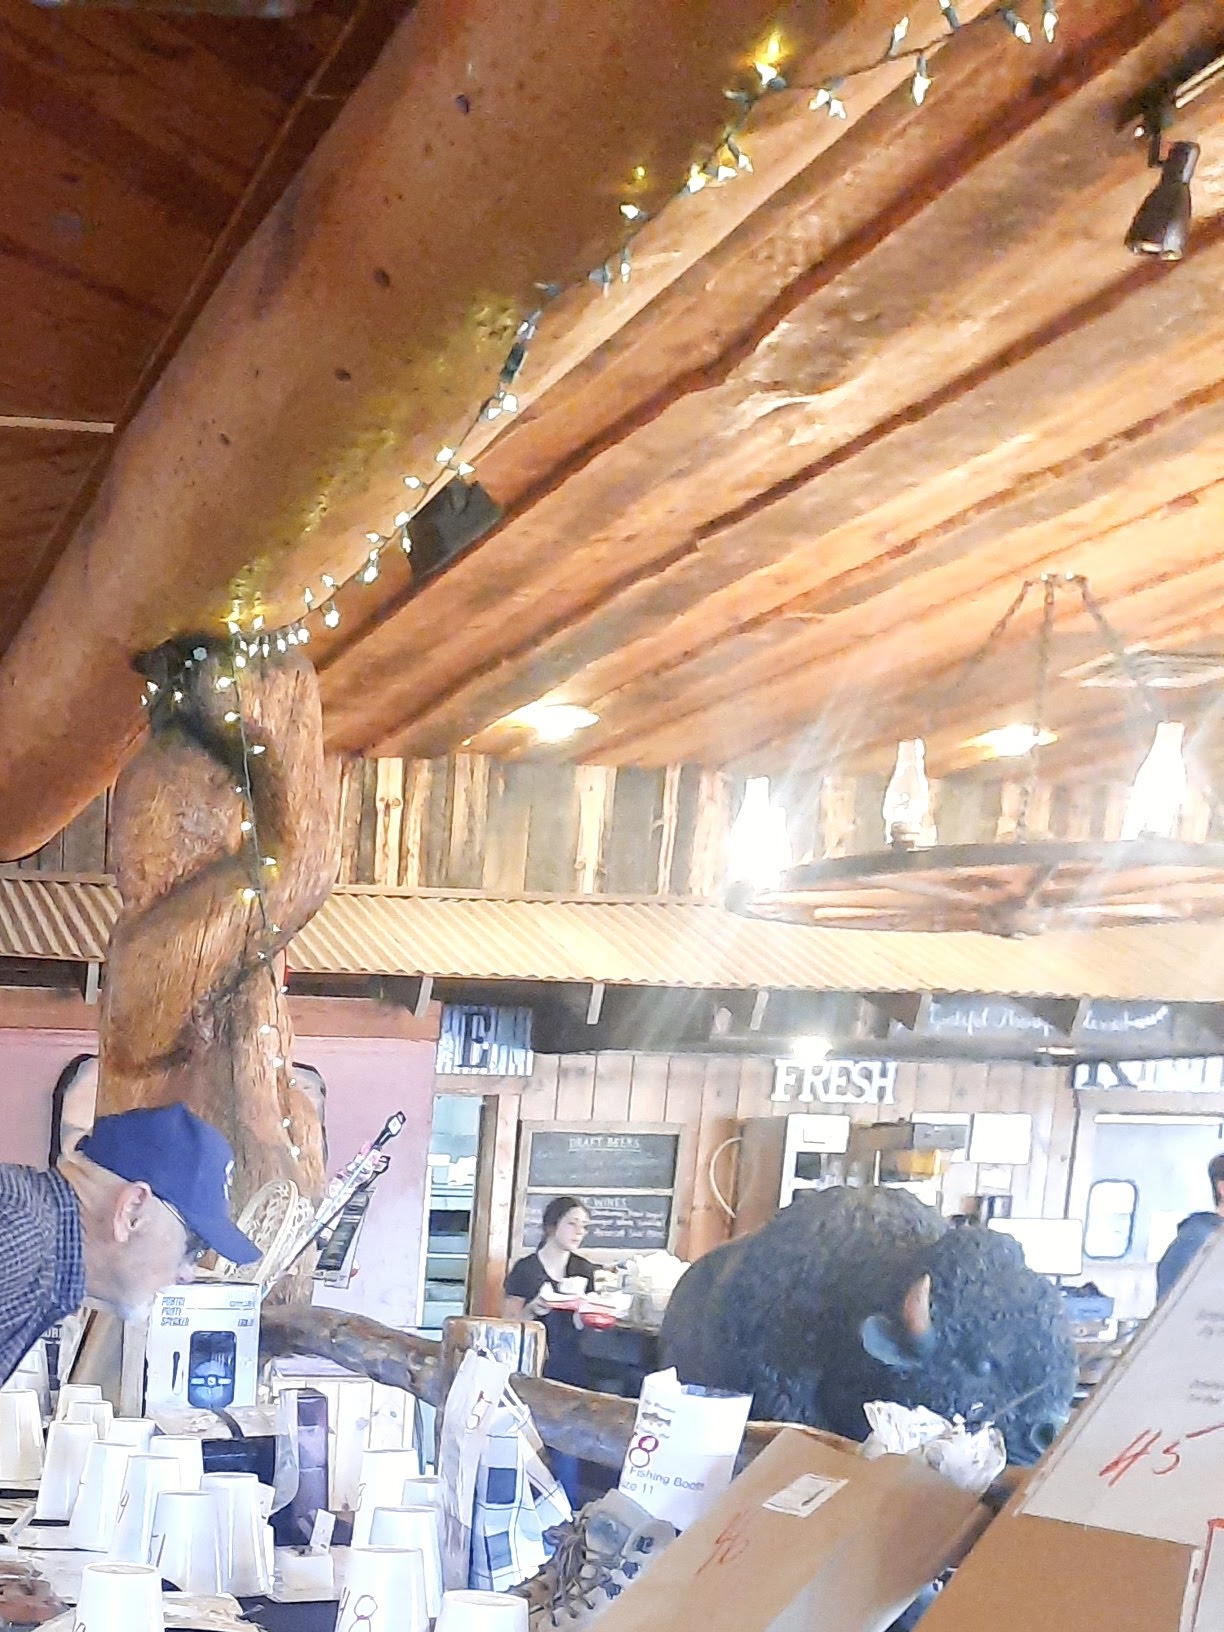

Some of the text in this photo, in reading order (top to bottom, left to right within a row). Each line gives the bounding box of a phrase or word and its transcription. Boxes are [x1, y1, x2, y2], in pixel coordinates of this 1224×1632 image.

[771, 1059, 897, 1104] FRESH
[569, 1136, 640, 1148] DRAFT BEERS
[630, 1467, 670, 1485] Fishing
[642, 1483, 654, 1494] 11
